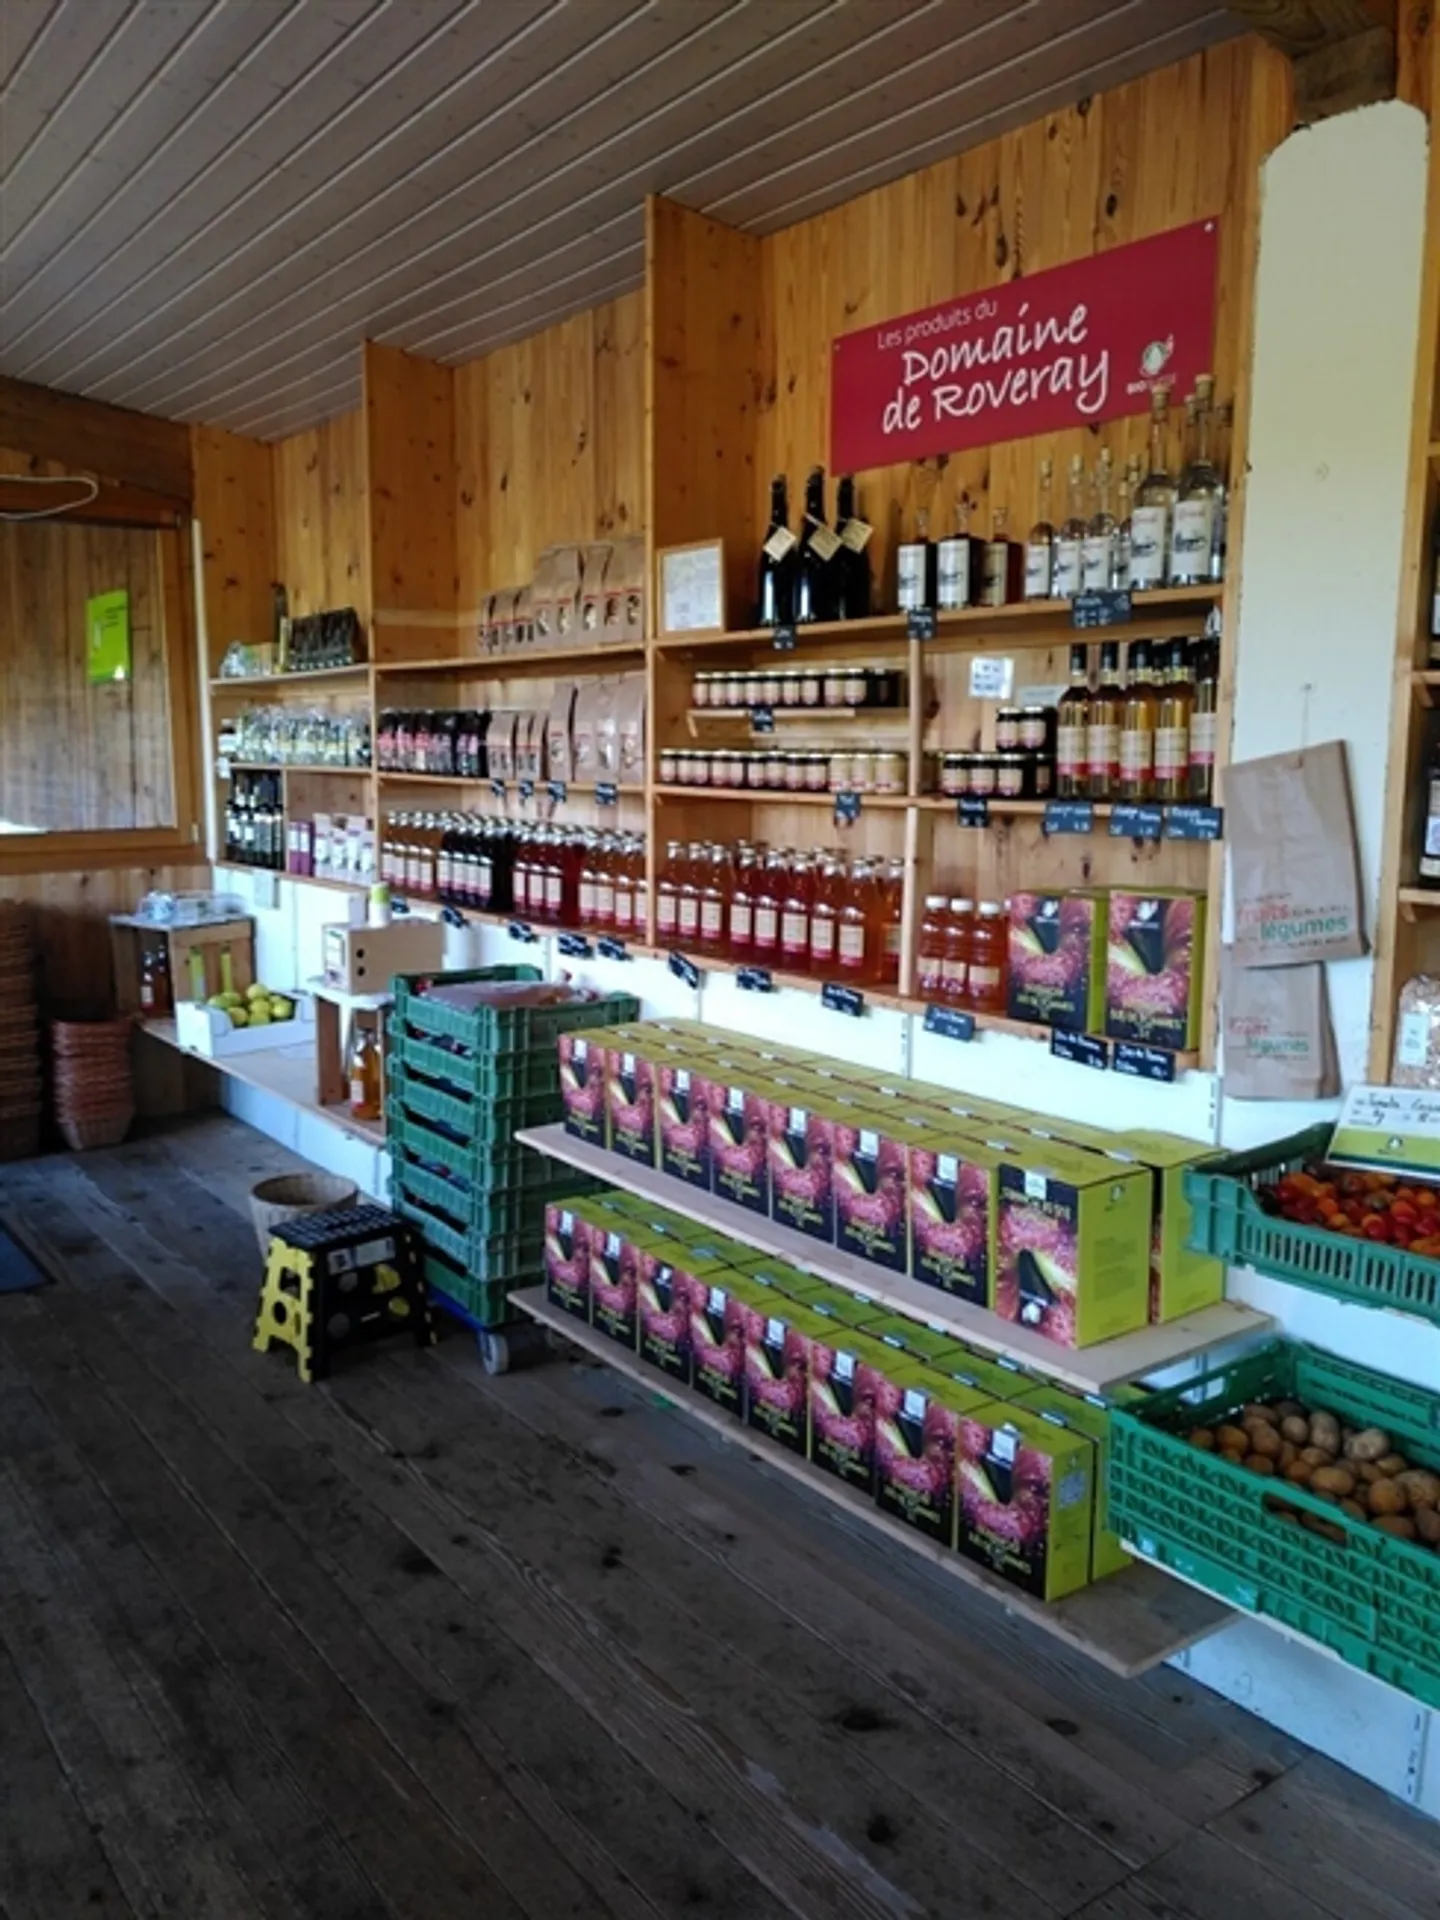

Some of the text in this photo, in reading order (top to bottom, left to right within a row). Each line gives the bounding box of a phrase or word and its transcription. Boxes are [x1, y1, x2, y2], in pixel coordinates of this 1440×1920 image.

[877, 298, 998, 349] Les produits du
[902, 302, 1088, 386] Domaine
[882, 350, 1109, 434] de Roveray
[1259, 915, 1348, 941] légumes
